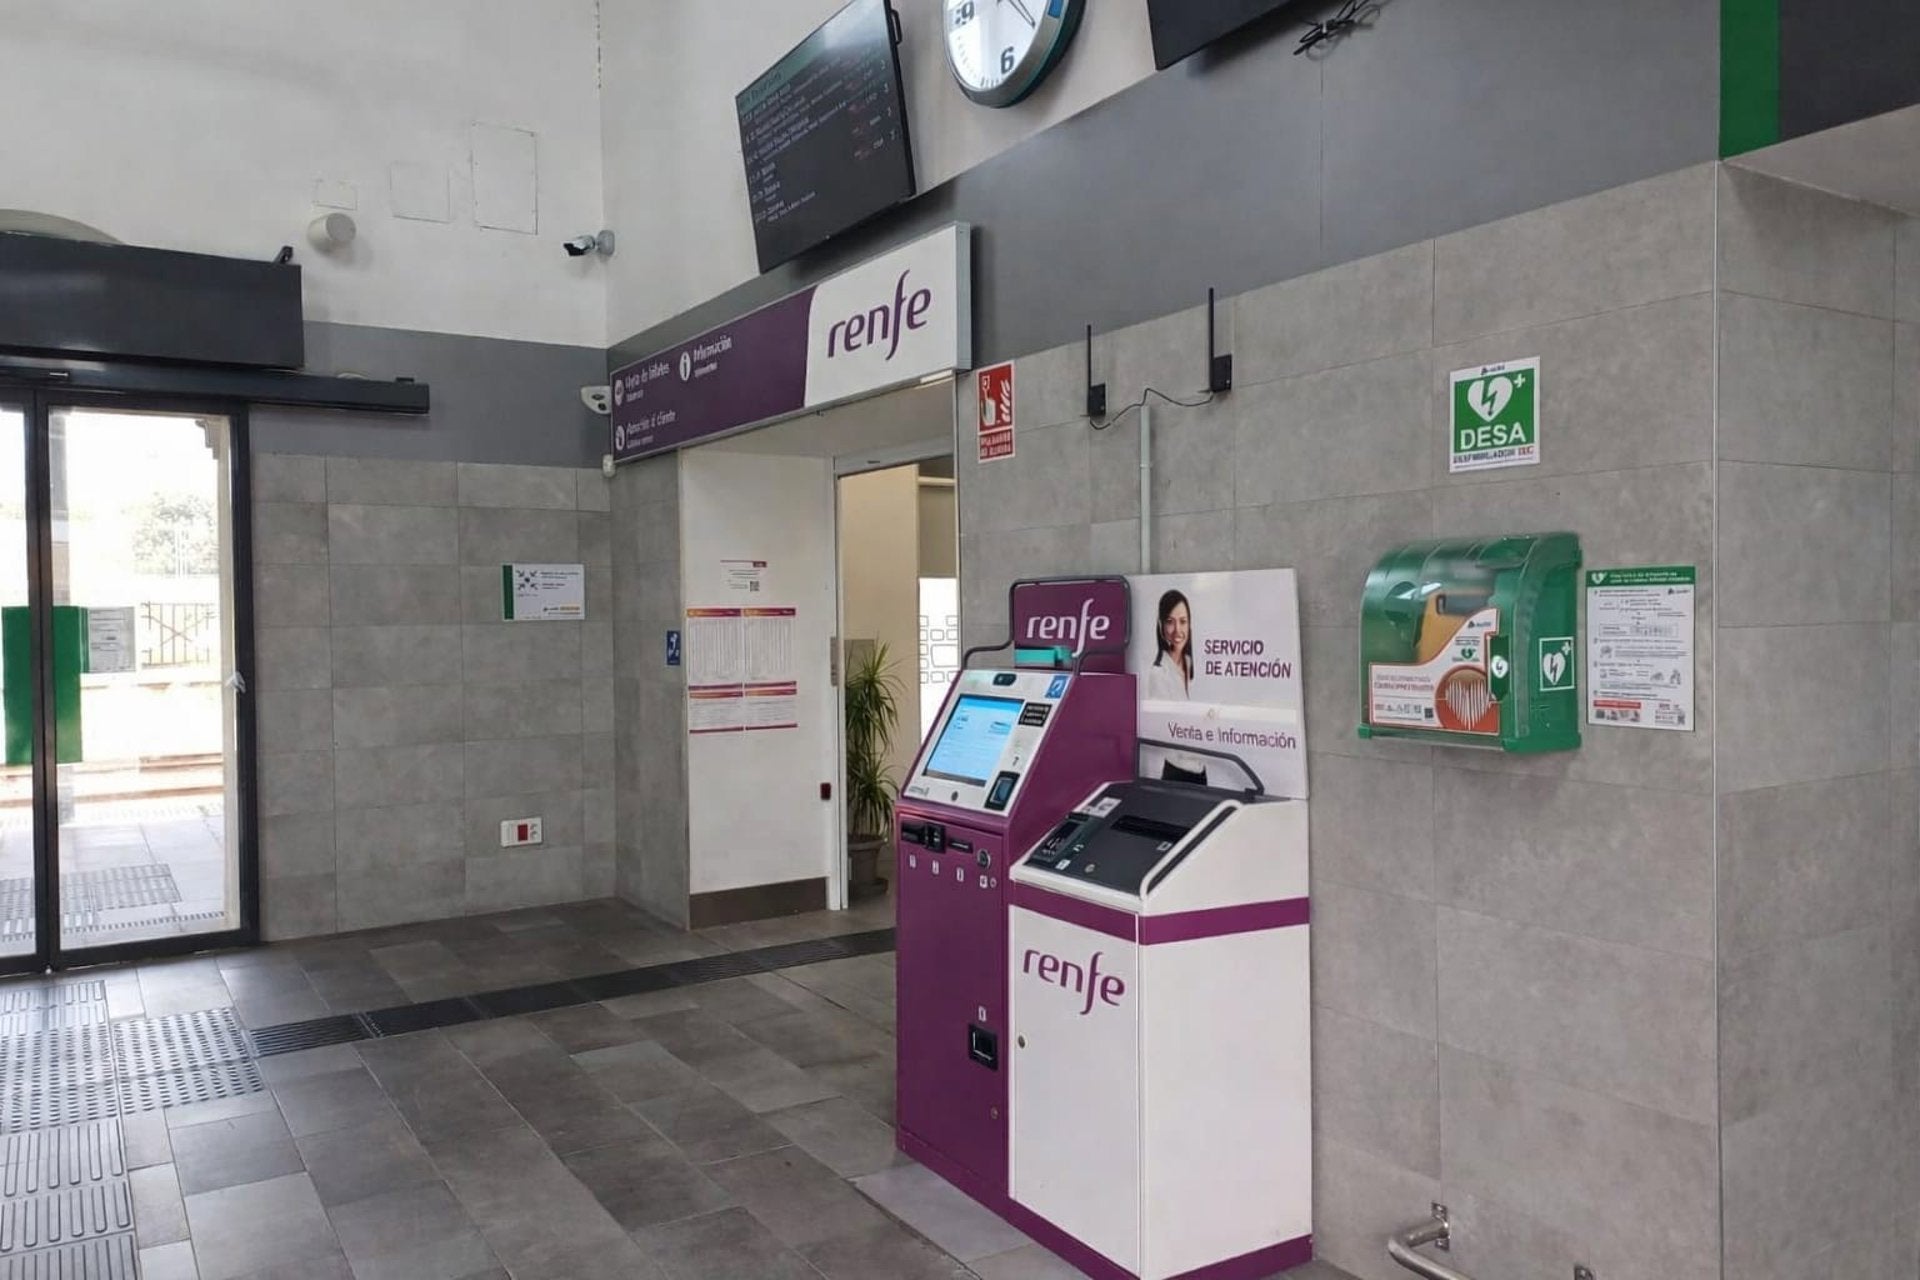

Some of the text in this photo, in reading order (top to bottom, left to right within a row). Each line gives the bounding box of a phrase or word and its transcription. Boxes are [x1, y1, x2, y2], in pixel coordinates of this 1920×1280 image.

[1000, 46, 1015, 75] 6
[827, 269, 932, 361] renfe
[1460, 421, 1527, 451] DESA
[1026, 598, 1111, 659] renfe
[1204, 639, 1265, 656] SERVICIO
[1205, 657, 1292, 680] DE ATENCIÓN
[1168, 721, 1297, 750] Venta e Información
[1023, 949, 1125, 1015] renfe
